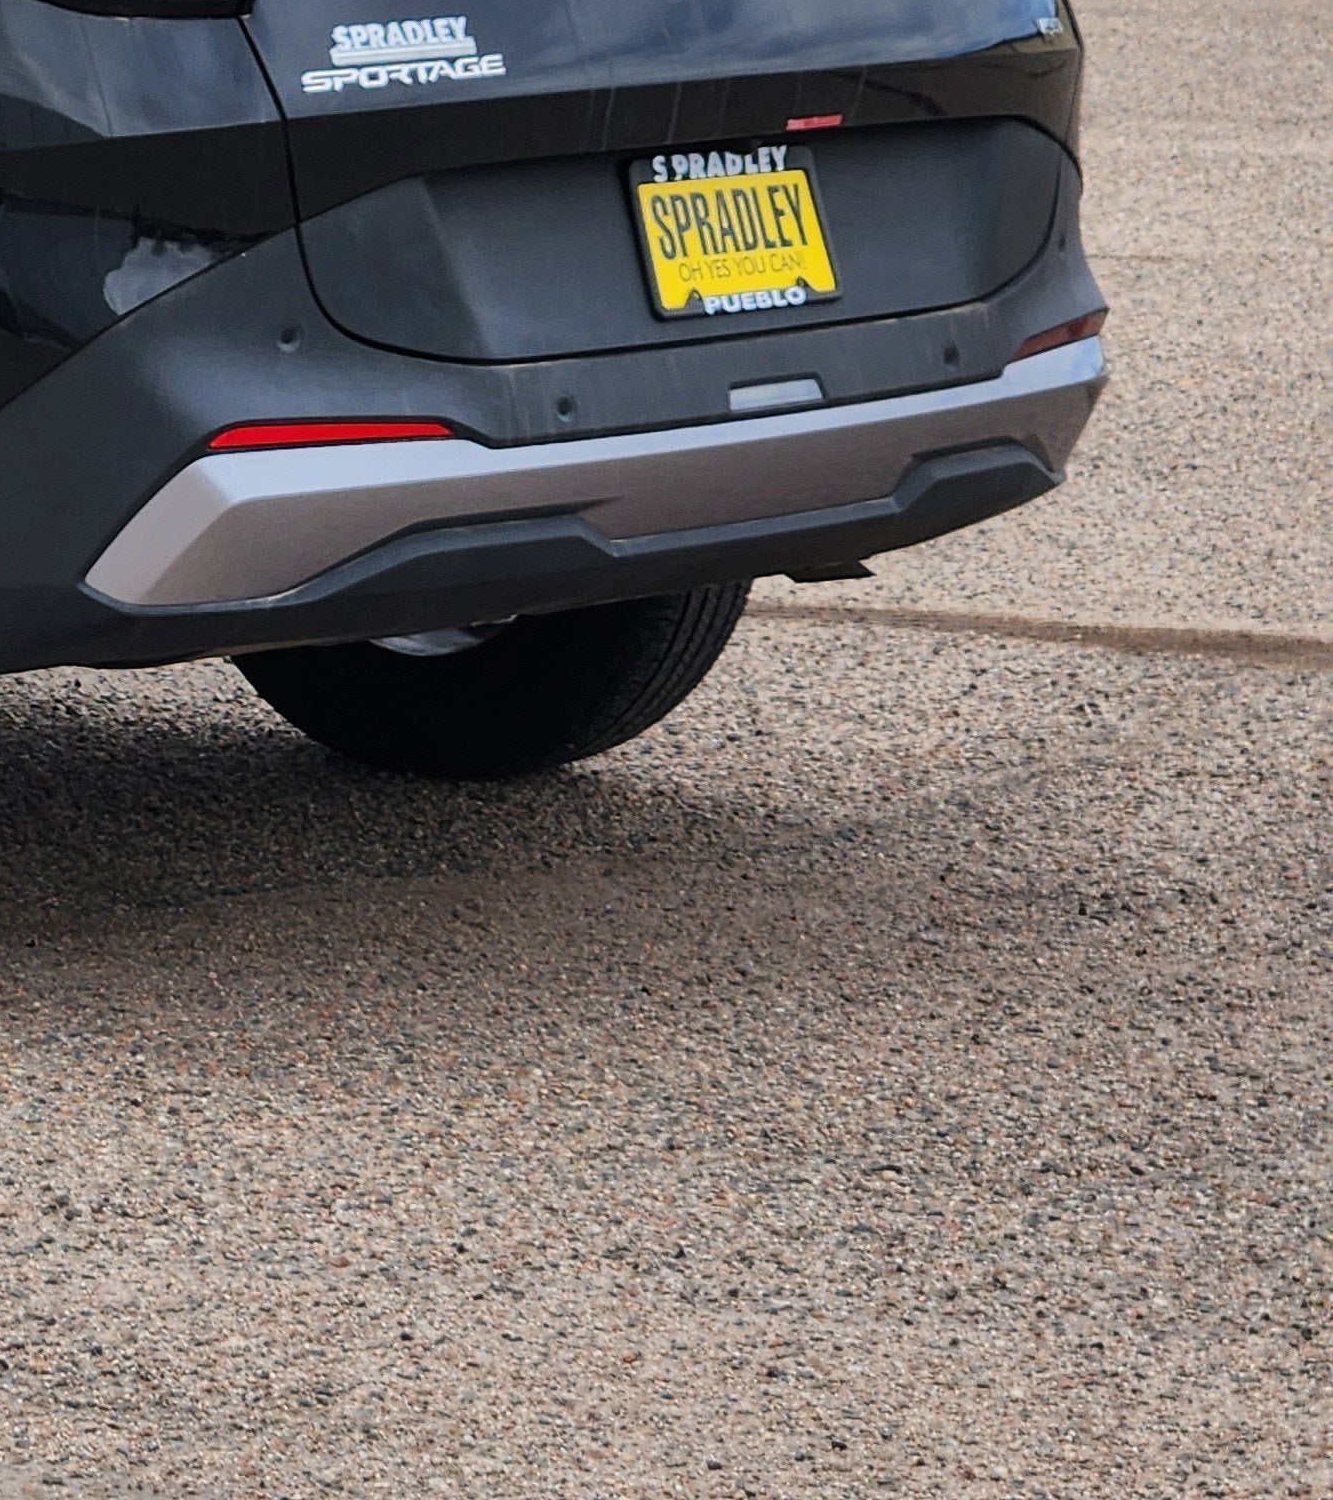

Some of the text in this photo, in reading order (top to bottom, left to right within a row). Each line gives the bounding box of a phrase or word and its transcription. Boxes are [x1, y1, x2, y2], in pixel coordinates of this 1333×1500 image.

[331, 15, 469, 50] SPRADLEY
[301, 53, 507, 93] SPORTAGE
[651, 183, 809, 260] SPRADLEY
[678, 262, 704, 282] OH
[704, 258, 732, 280] YES
[733, 255, 767, 277] YOU
[703, 285, 809, 316] PUEBLO
